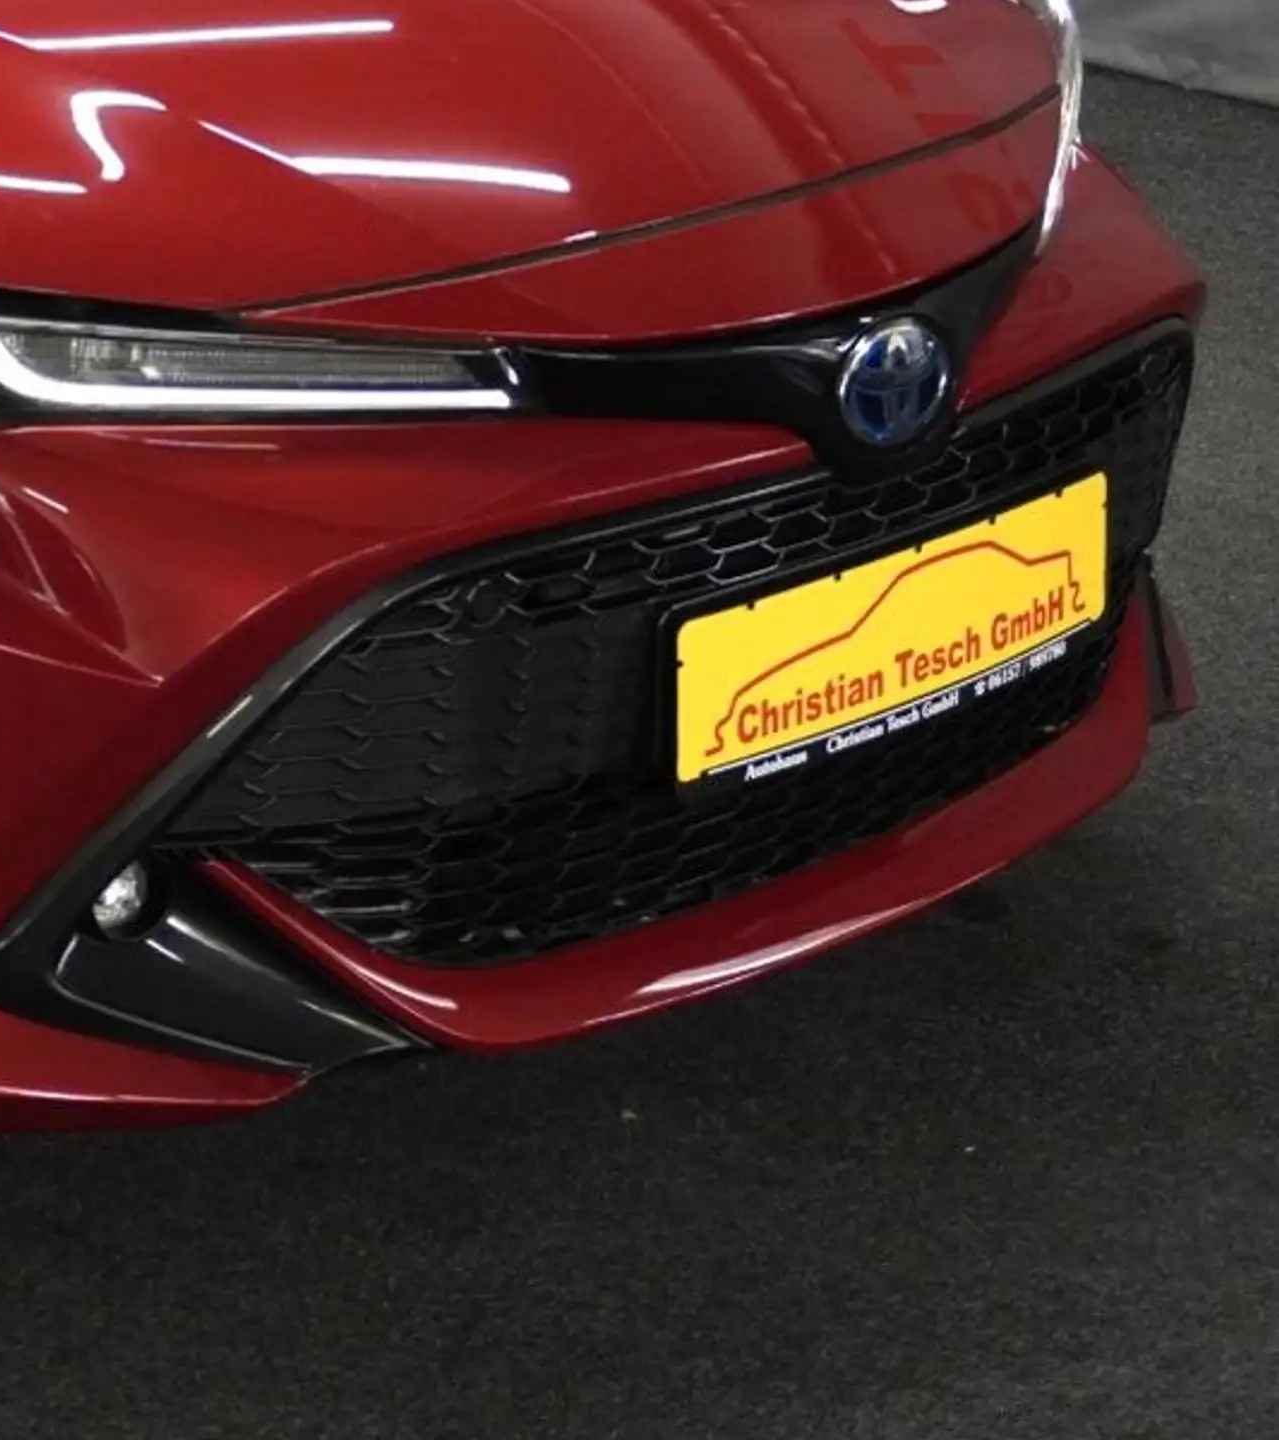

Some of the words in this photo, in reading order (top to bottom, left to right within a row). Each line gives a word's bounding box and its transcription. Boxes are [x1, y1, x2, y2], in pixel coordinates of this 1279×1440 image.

[736, 672, 884, 744] Christian
[894, 627, 981, 688] Tesch
[990, 586, 1066, 651] GmbH
